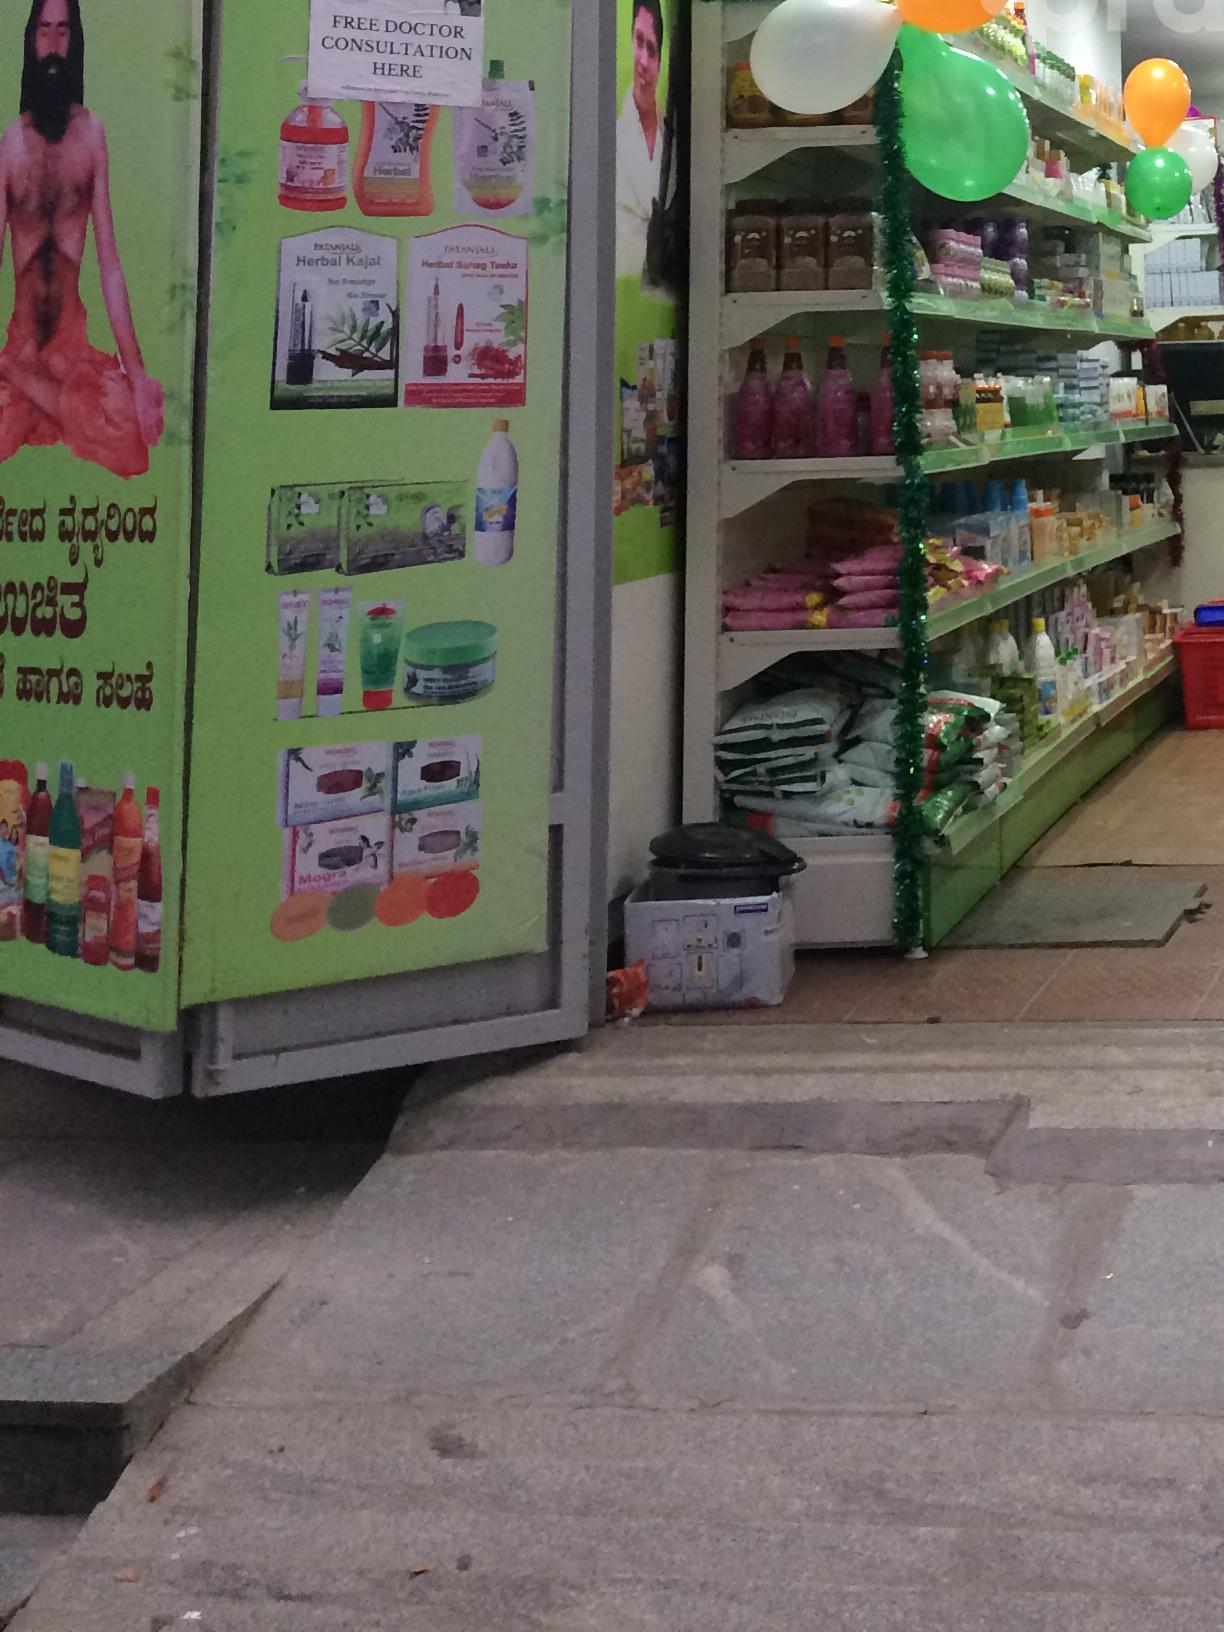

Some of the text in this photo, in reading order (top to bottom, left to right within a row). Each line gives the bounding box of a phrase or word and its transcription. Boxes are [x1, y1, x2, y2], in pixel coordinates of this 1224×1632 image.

[332, 14, 465, 39] FREE DOCTOR
[321, 35, 473, 61] CONSULTATION
[372, 61, 423, 78] HERE
[296, 255, 381, 269] Herbal Kajal
[16, 656, 83, 706] ಹಾಗೂ
